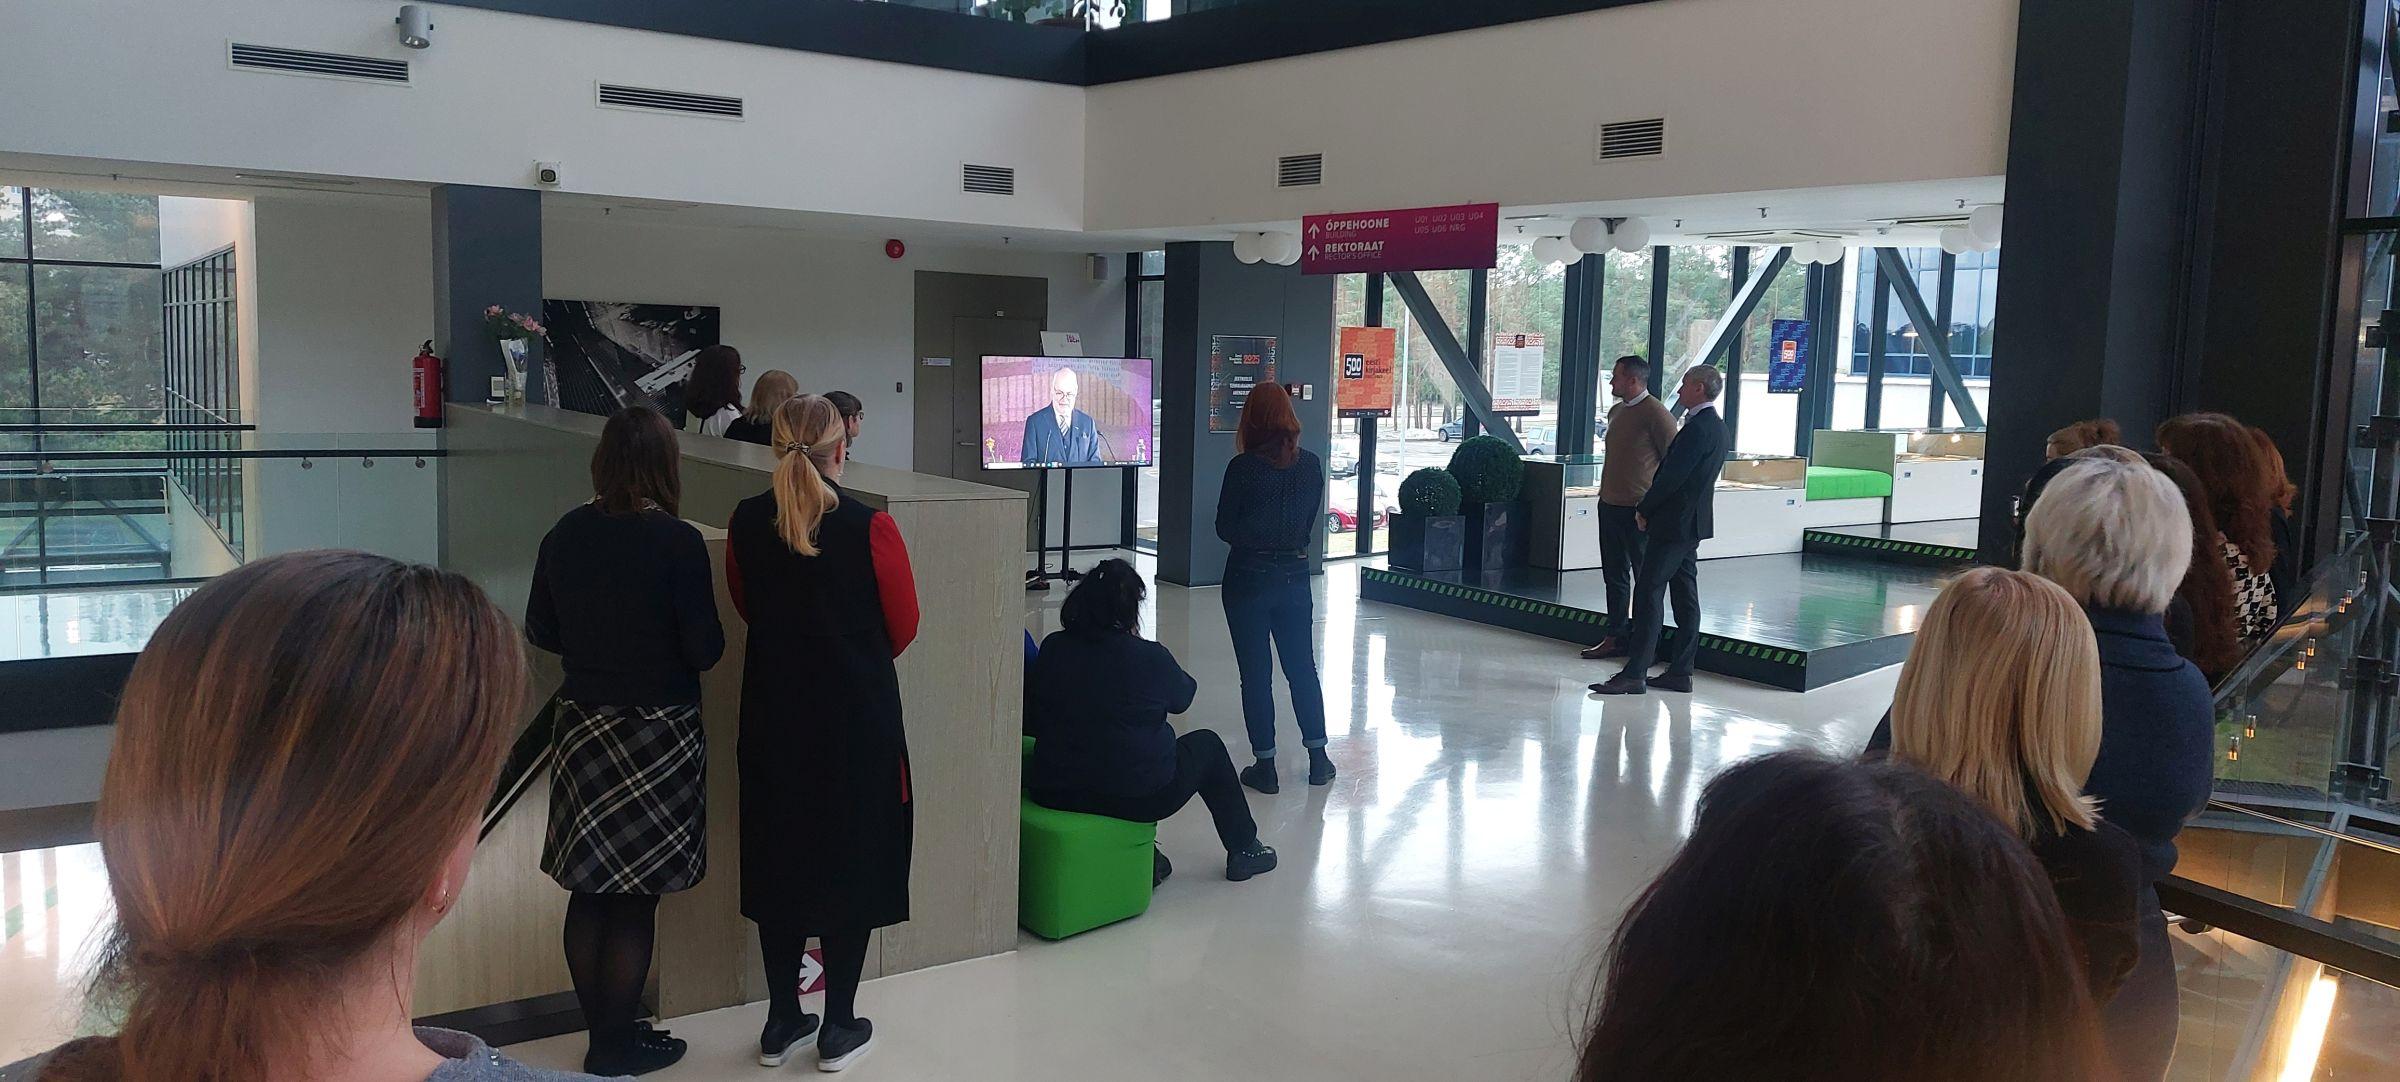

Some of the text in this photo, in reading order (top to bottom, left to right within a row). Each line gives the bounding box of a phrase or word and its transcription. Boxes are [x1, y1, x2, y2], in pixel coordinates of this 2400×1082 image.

[1325, 218, 1390, 231] ÕPPEHOONE
[1325, 231, 1357, 239] BUILDING
[1324, 241, 1385, 253] REKTORAAT
[1345, 357, 1362, 376] 500
